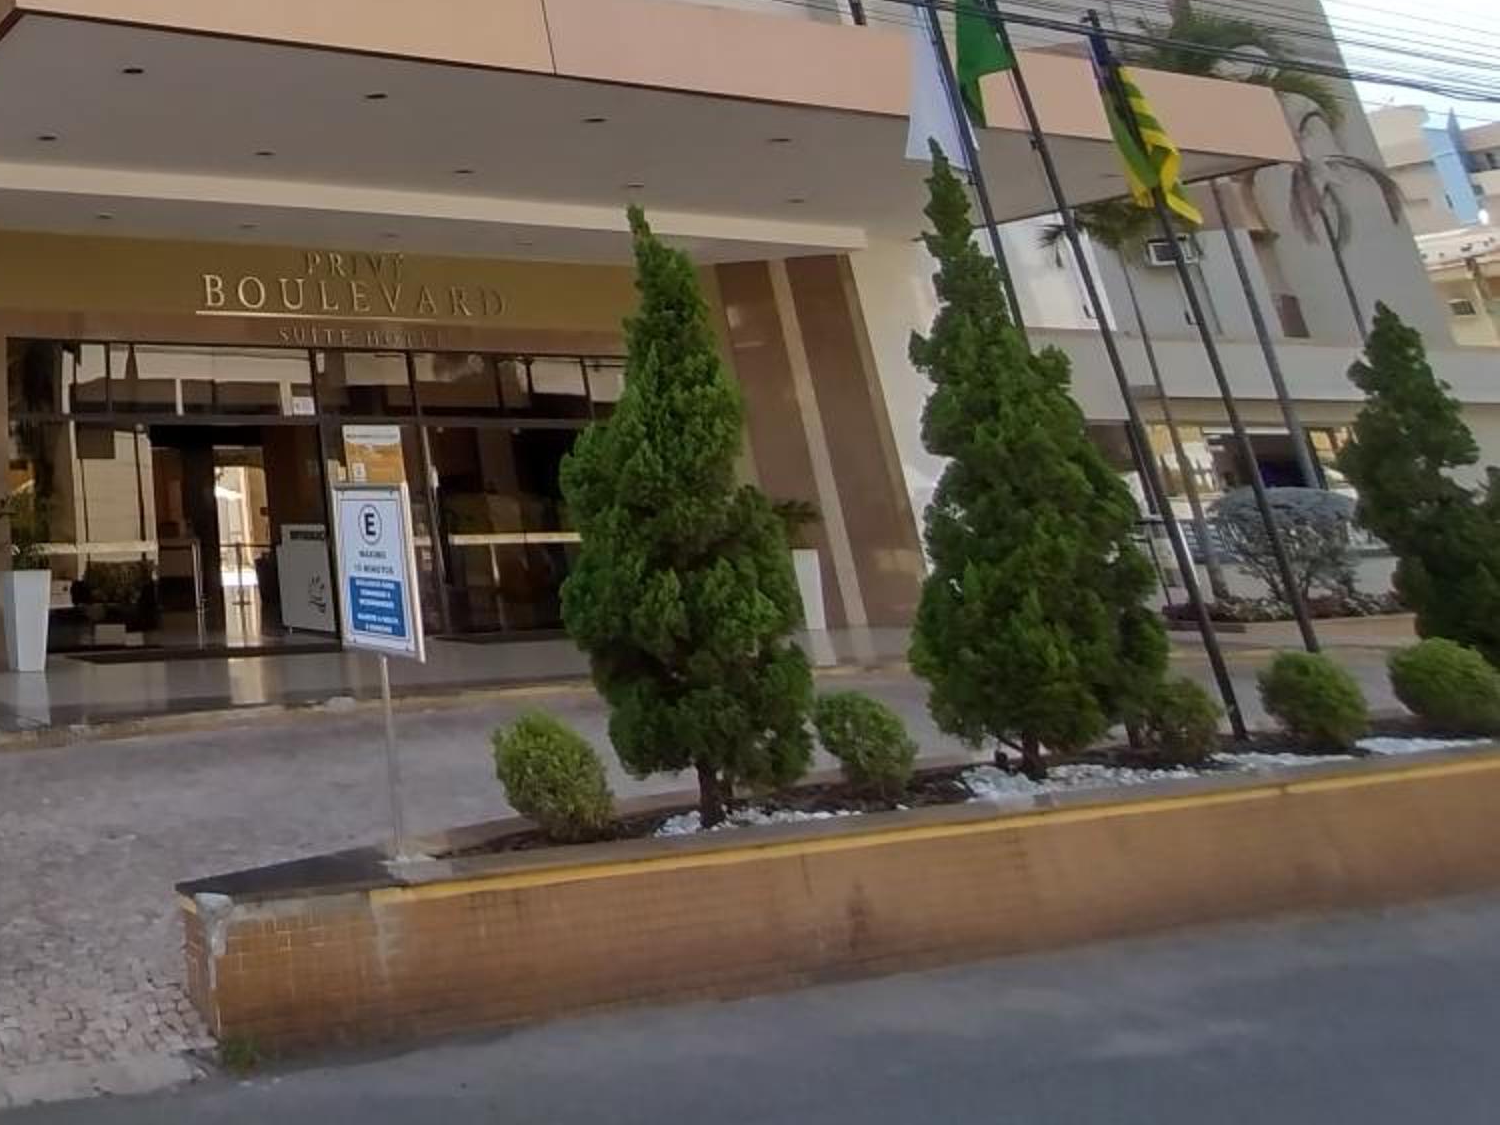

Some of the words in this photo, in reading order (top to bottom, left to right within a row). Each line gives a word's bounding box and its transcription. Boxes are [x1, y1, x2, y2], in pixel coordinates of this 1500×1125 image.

[202, 274, 508, 316] BOULEVARD
[278, 326, 352, 345] SUITE
[363, 512, 377, 537] E
